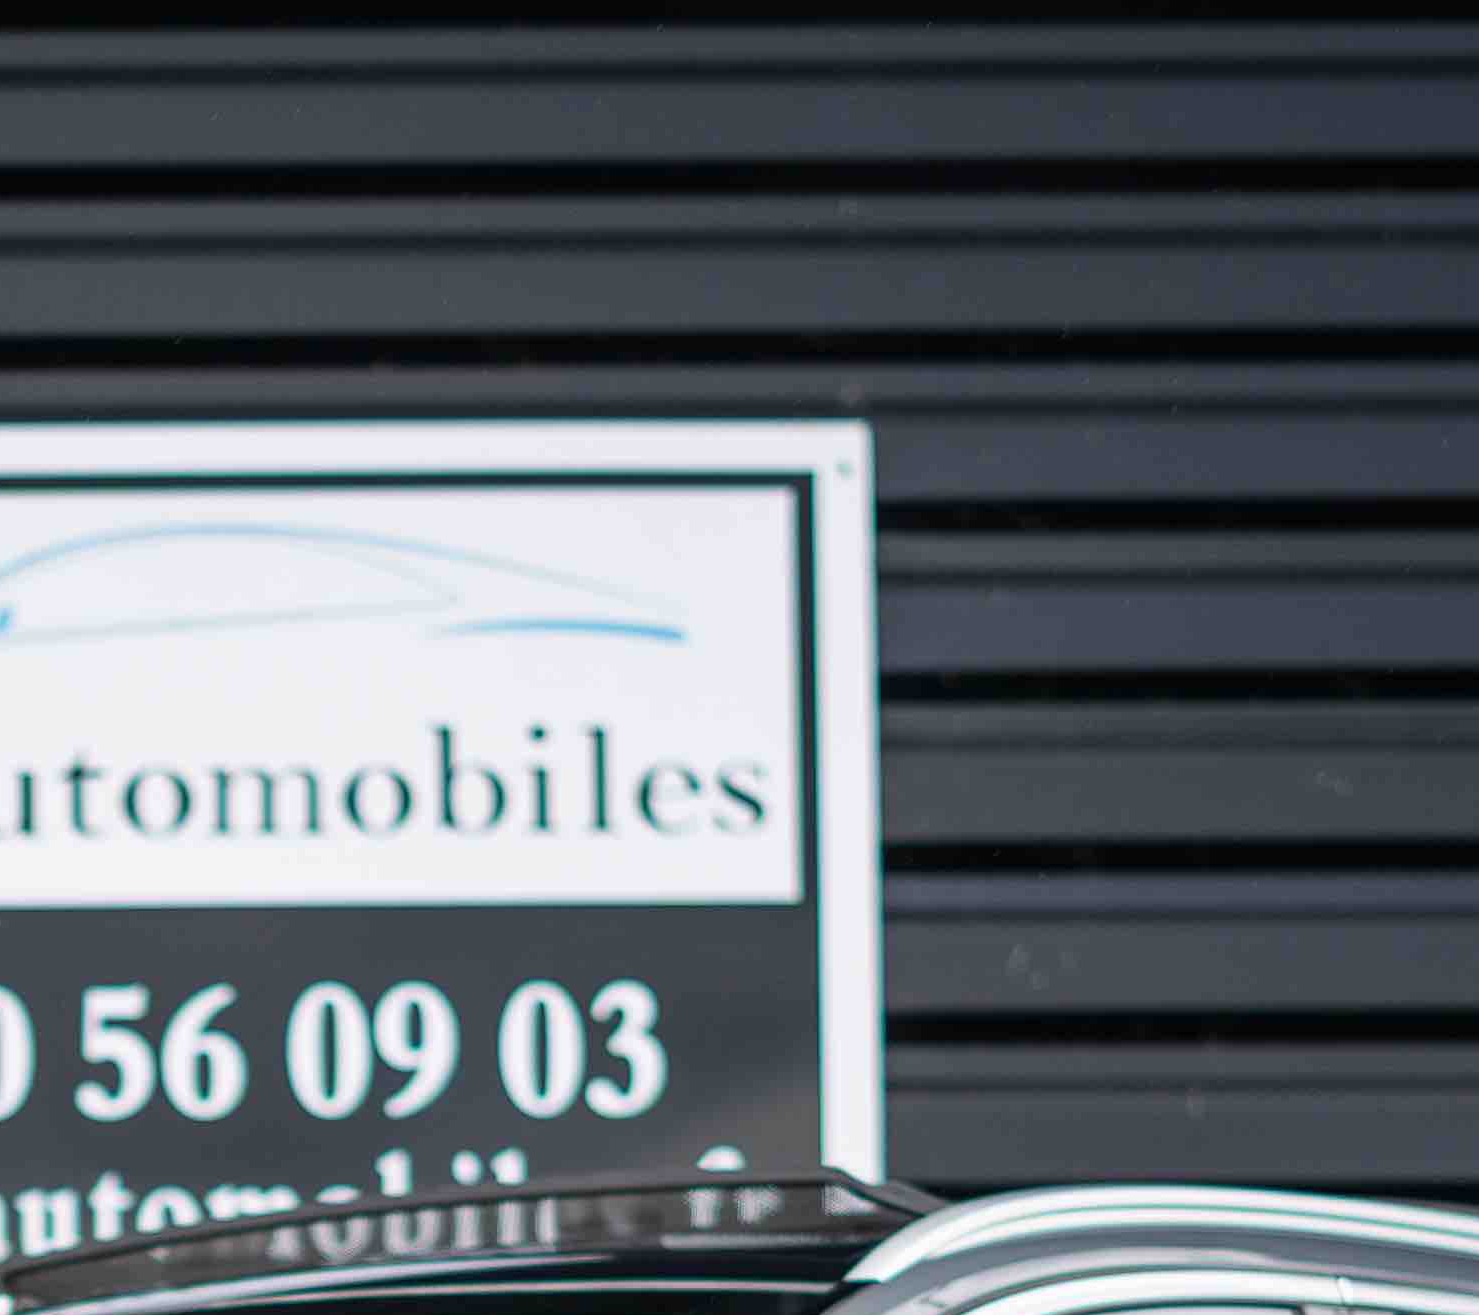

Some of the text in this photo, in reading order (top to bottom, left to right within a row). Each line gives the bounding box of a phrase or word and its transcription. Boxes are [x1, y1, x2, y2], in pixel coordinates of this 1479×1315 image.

[74, 984, 247, 1122] 56
[285, 982, 458, 1120] 09
[497, 980, 667, 1119] 03
